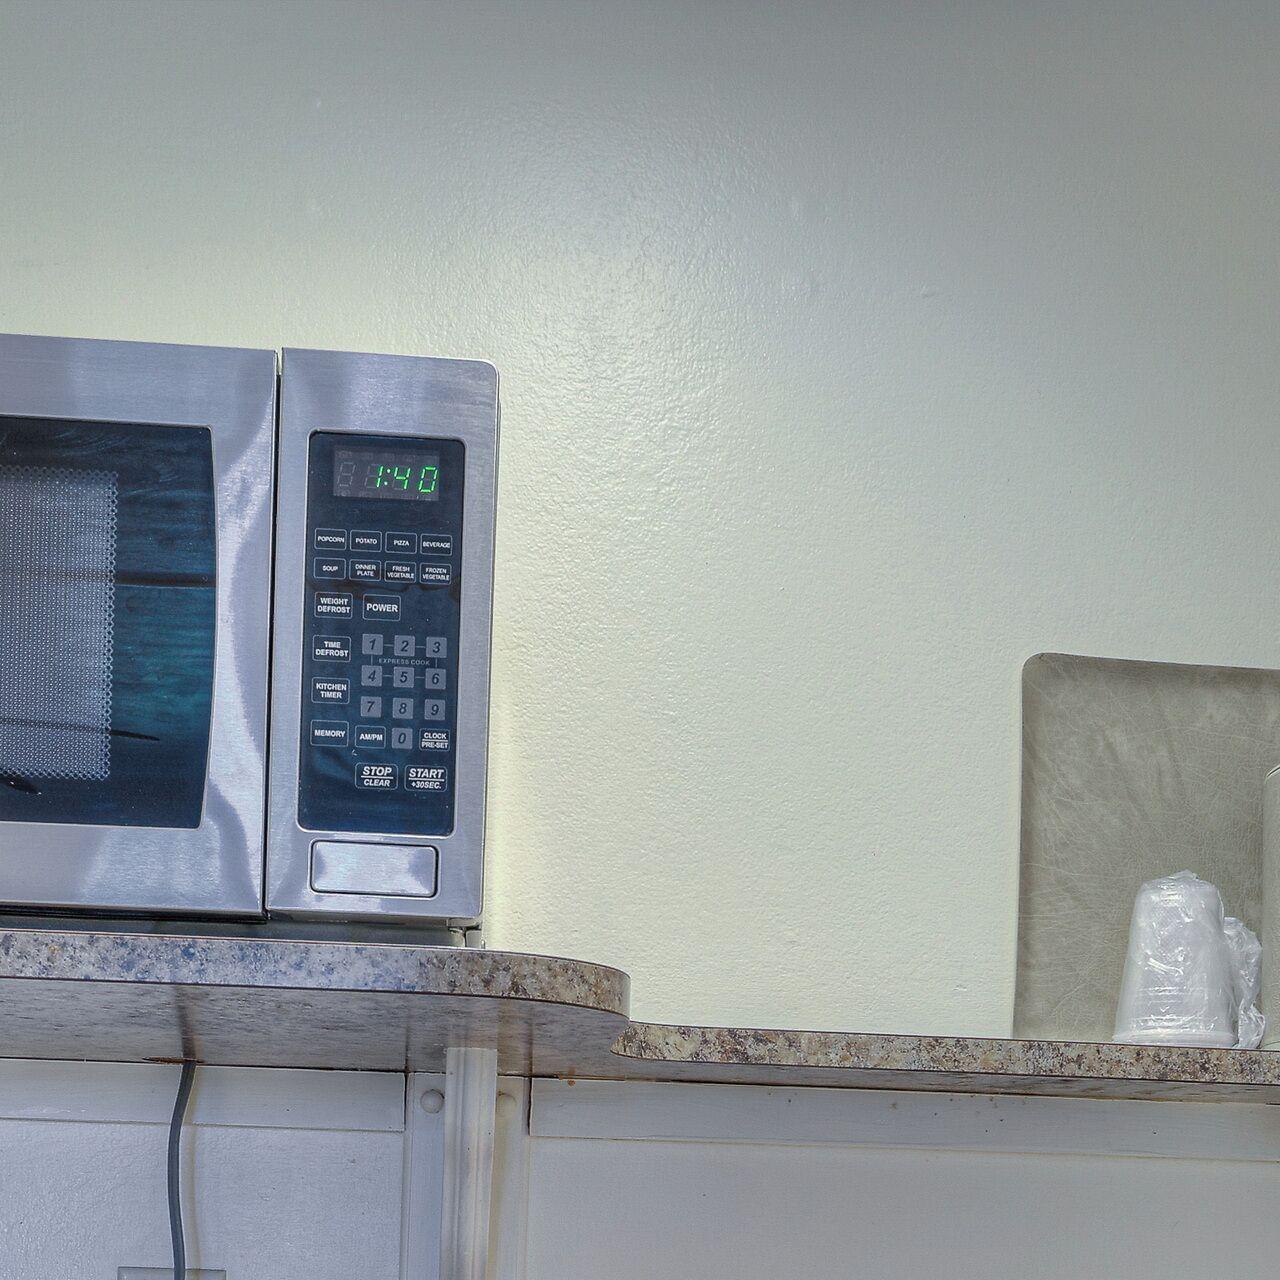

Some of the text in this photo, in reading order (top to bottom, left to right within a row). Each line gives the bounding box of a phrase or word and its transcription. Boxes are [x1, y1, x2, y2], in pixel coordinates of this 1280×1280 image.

[376, 466, 438, 493] 1:40
[317, 535, 345, 543] POPCORN
[355, 537, 377, 545] POTATO
[422, 541, 451, 549] BEVERAGE
[422, 573, 450, 581] VEGETABLE
[320, 597, 349, 605] WEIGHT
[317, 605, 351, 613] DEFROST
[366, 603, 398, 612] POWER
[369, 638, 376, 650] 1
[400, 640, 409, 652] 2
[432, 641, 441, 653] 3
[315, 649, 349, 657] DEFROST
[368, 670, 376, 682] 4
[400, 671, 408, 683] 5
[431, 673, 440, 685] 6
[316, 682, 347, 691] KITCHEN
[320, 691, 342, 699] TIMER
[367, 701, 375, 712] 7
[398, 702, 407, 714] 8
[431, 704, 439, 716] 9
[314, 729, 346, 738] MEMORY
[359, 733, 383, 741] AM/PM
[398, 732, 407, 744] 0
[421, 741, 448, 749] PRE-SET
[362, 766, 393, 776] STOP
[409, 768, 444, 778] START
[363, 779, 391, 787] CLEAR
